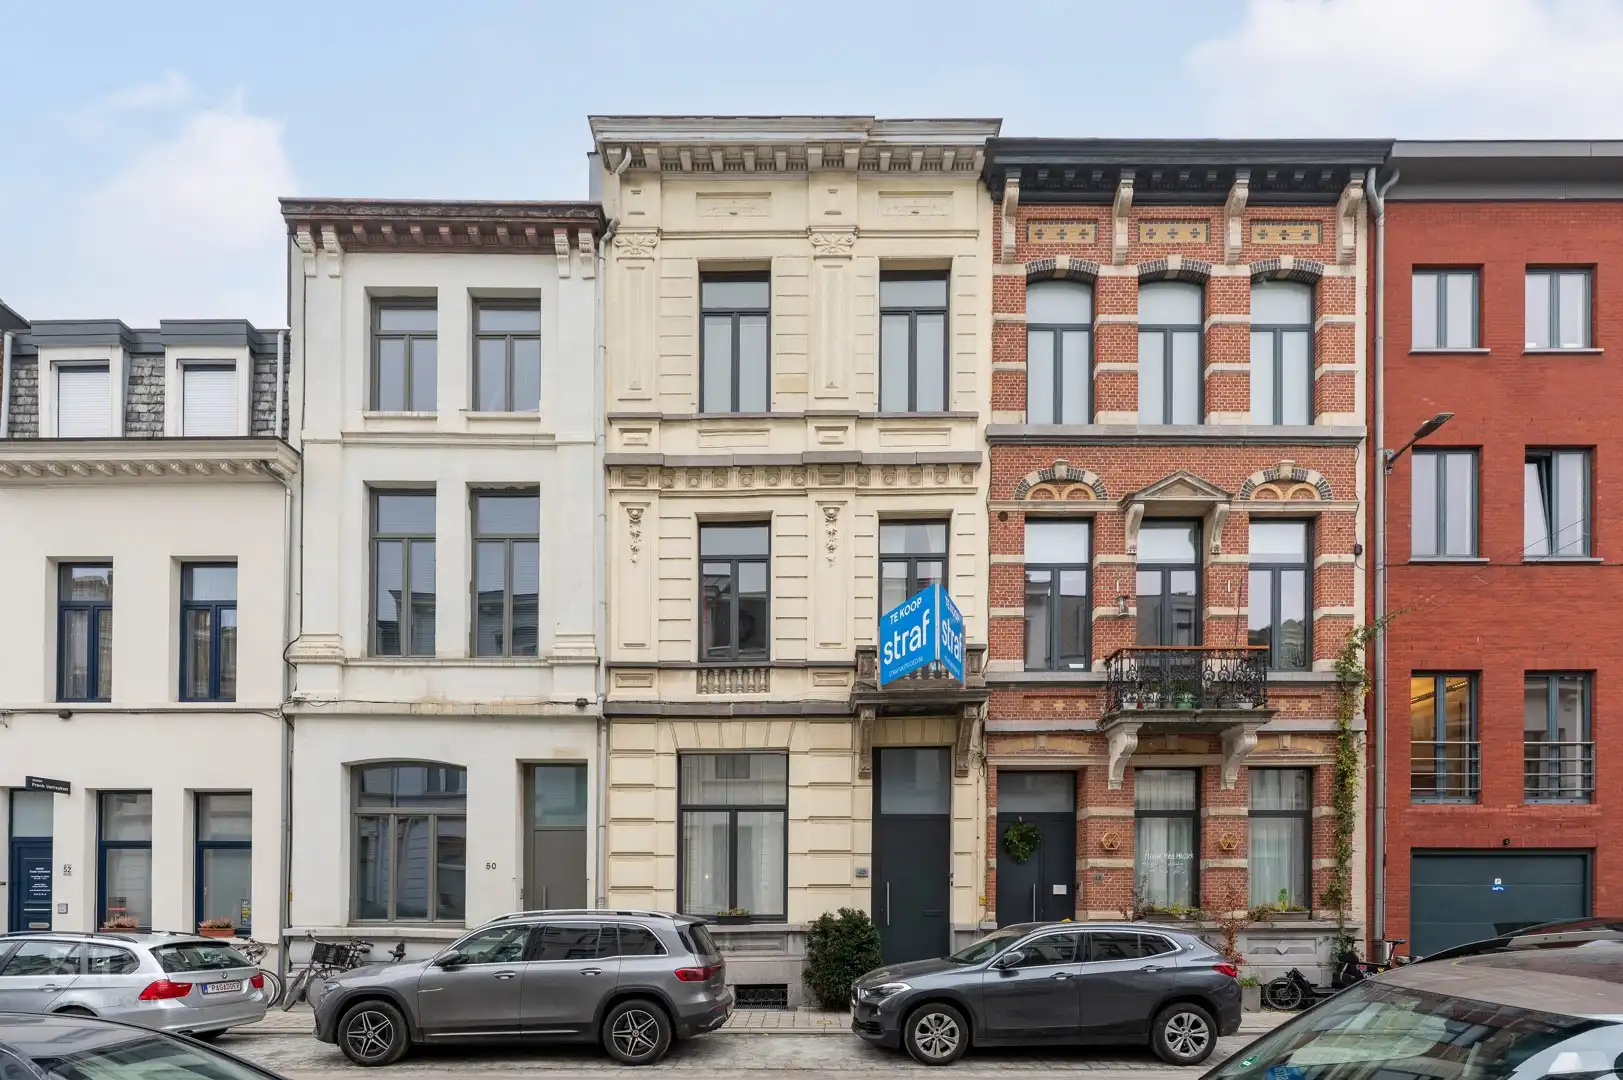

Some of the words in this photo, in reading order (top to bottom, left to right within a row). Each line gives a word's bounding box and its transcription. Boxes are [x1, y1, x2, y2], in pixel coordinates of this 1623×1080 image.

[889, 613, 898, 624] TE
[899, 597, 922, 619] KOOP
[884, 608, 930, 665] straf
[941, 619, 962, 663] straf
[486, 862, 497, 870] 50
